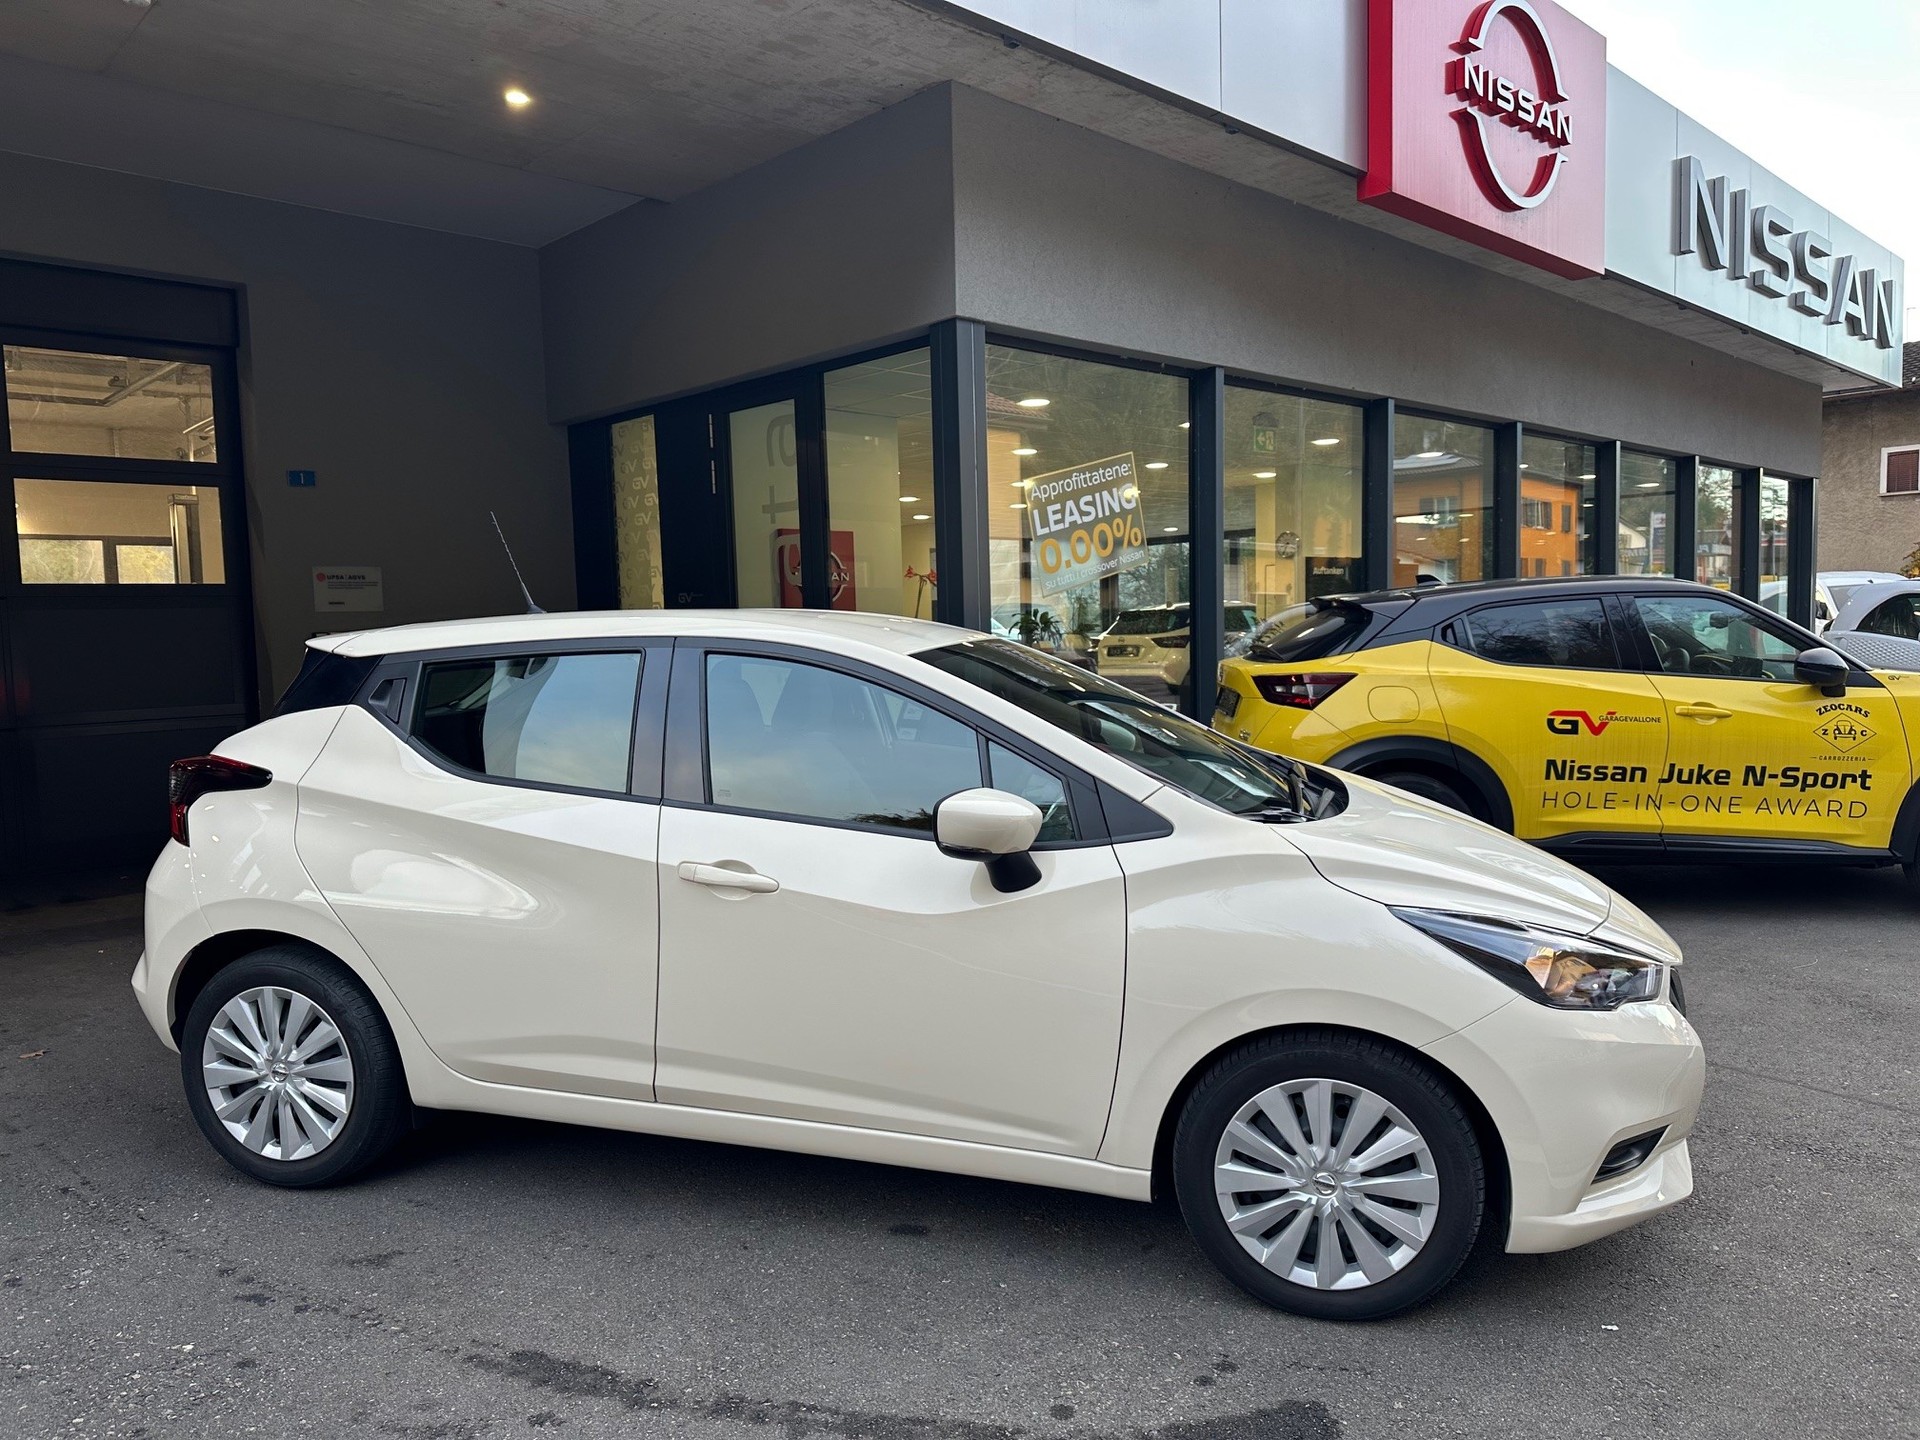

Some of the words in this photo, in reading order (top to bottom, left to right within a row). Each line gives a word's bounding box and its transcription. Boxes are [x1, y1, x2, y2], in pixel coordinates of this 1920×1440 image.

[1463, 55, 1573, 146] NISSAN
[1671, 155, 1897, 349] NISSAN
[299, 472, 304, 484] 1
[1031, 463, 1132, 502] Approfittatene:
[1033, 483, 1137, 536] LEASING
[1040, 514, 1142, 575] 0.00%
[1045, 580, 1057, 590] su
[1058, 572, 1074, 586] tutti
[1080, 559, 1118, 577] crossover
[1119, 550, 1144, 565] Nissan
[1546, 710, 1617, 736] GV
[1598, 715, 1661, 723] GARAGEVALLONE
[1815, 703, 1870, 718] ZEOCARS
[1860, 729, 1867, 737] C
[1544, 759, 1647, 783] Nissan
[1658, 763, 1731, 785] Juke
[1742, 765, 1873, 793] N-Sport
[1541, 790, 1743, 815] HOLE-IN-ONE
[1755, 797, 1868, 819] AWARD
